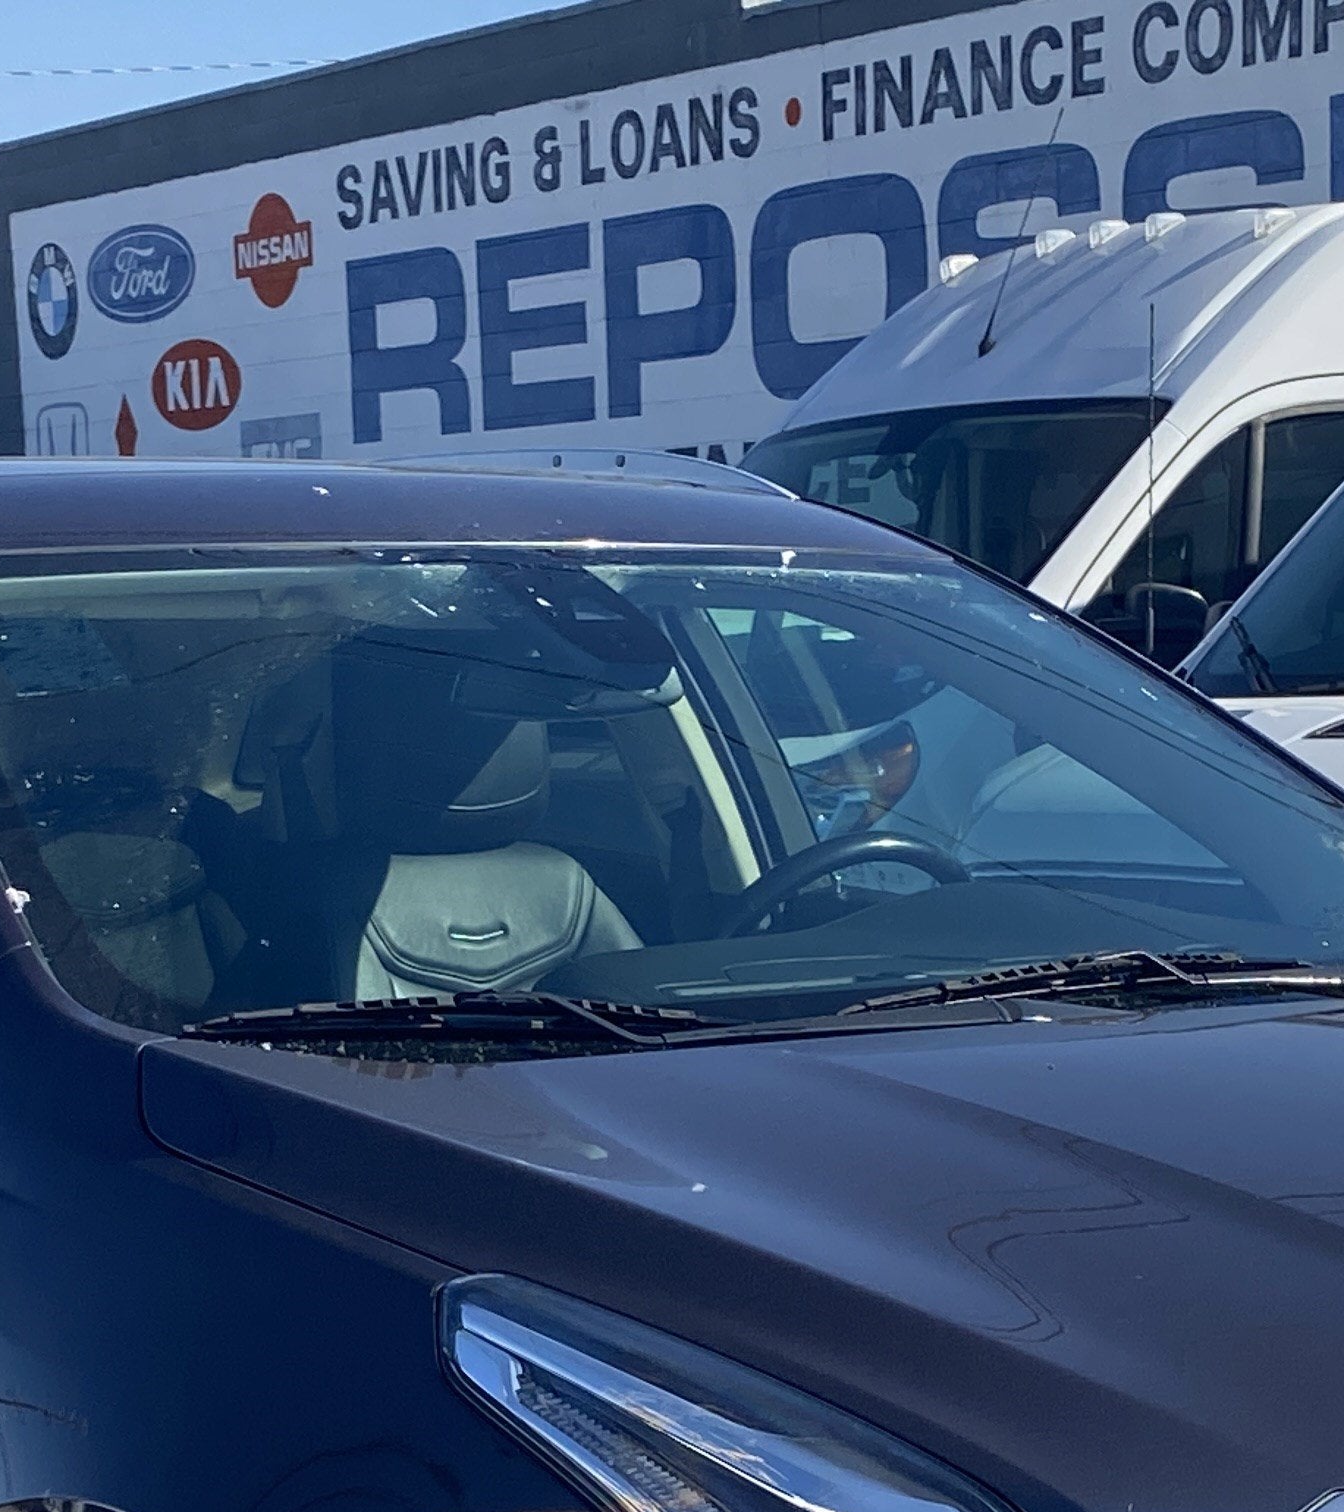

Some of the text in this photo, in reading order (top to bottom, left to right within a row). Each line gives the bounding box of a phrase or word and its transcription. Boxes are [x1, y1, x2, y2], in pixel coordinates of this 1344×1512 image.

[336, 137, 511, 231] SAVING
[533, 125, 562, 193] &
[579, 86, 760, 185] LOANS
[821, 18, 1106, 142] FINANCE
[110, 246, 172, 301] Ford
[238, 231, 308, 270] NISSAN
[164, 355, 231, 412] KIA
